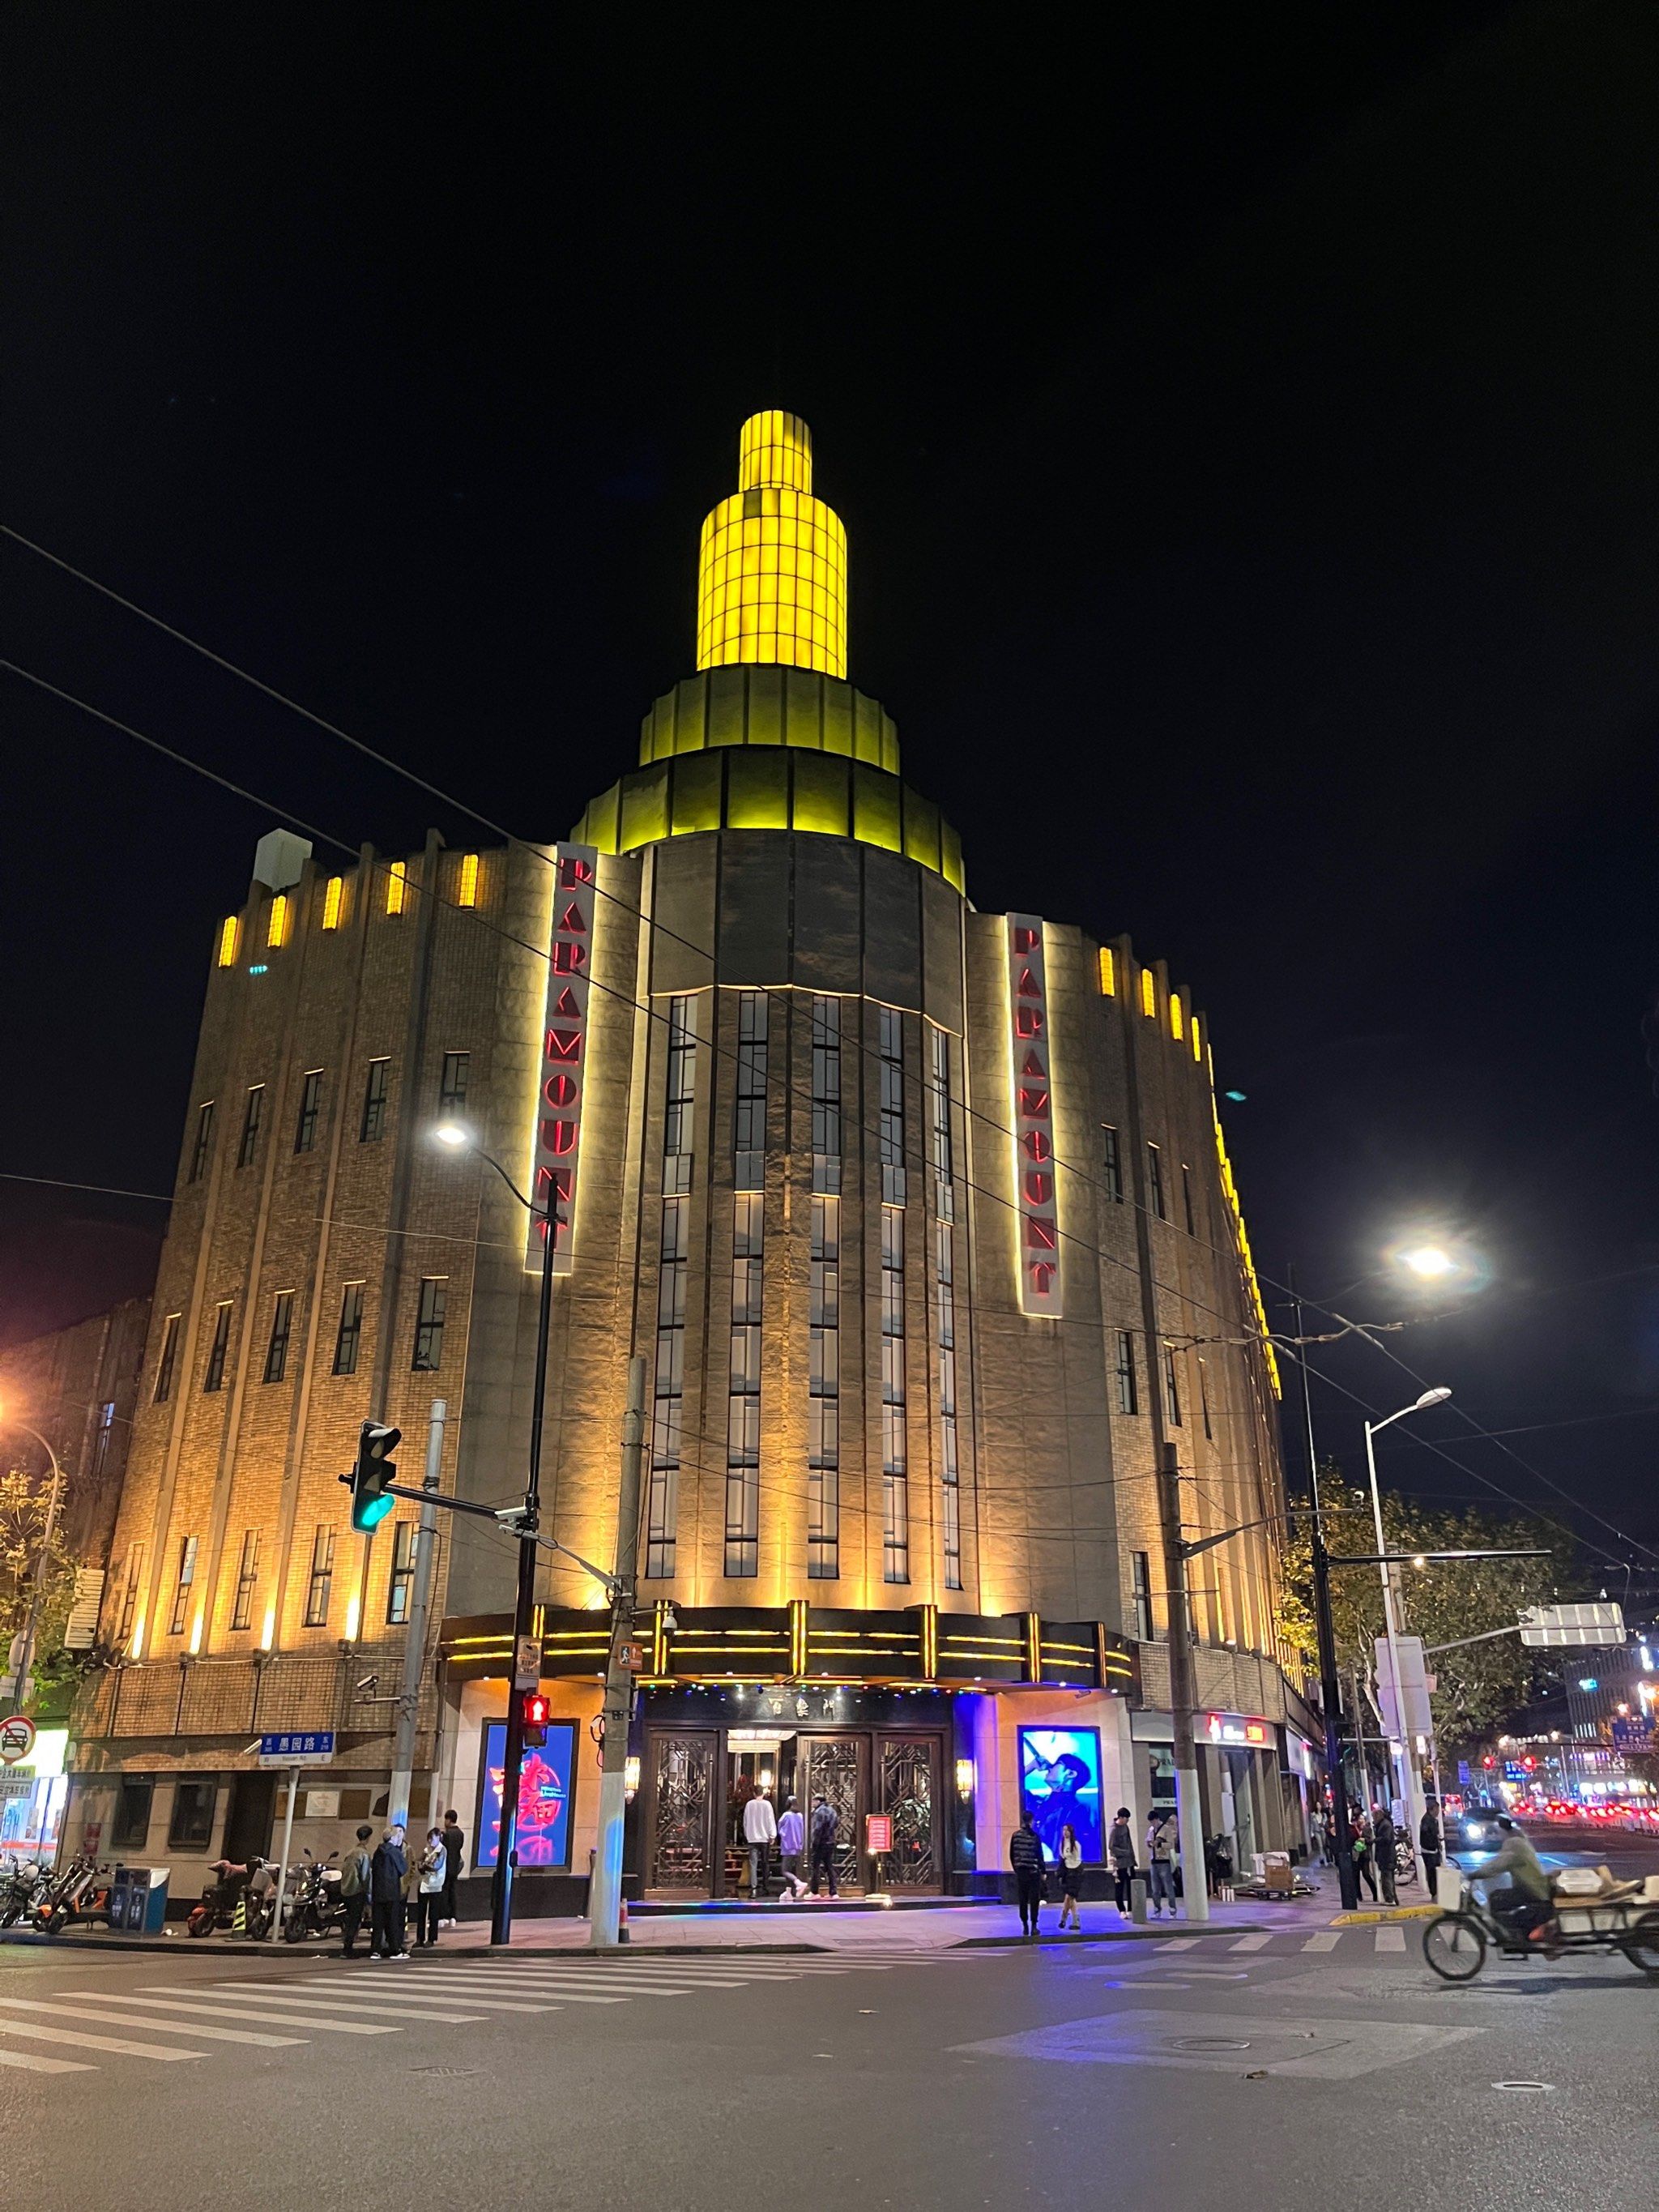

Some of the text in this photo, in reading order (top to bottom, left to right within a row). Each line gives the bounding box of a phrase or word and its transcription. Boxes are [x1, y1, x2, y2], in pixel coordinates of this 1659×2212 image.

[535, 857, 593, 1249] PARAMOUNT
[1014, 927, 1056, 1296] PARAMOUNT
[279, 1737, 314, 1751] 愚园路
